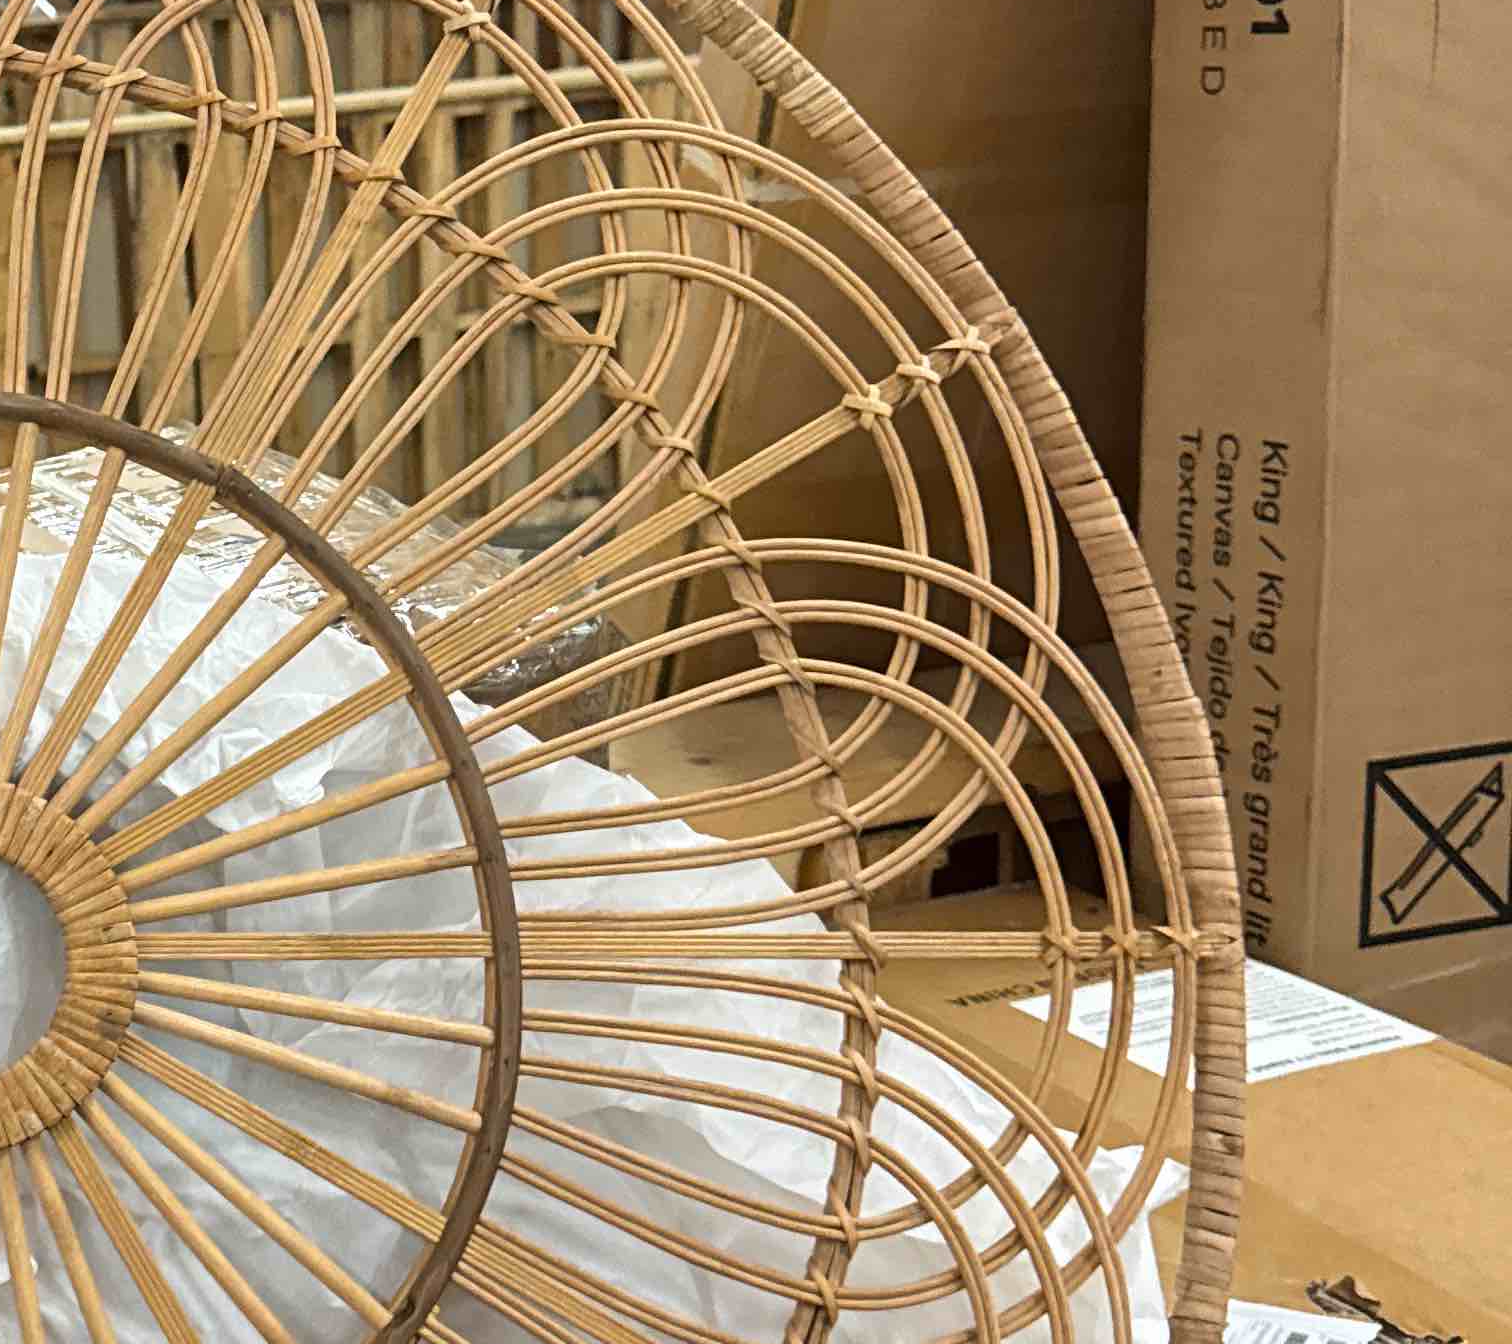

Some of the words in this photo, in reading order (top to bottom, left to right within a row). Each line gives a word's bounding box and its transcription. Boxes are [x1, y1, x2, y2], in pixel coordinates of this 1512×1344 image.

[1175, 427, 1203, 593] Textured
[1212, 433, 1240, 568] Canvas
[1253, 439, 1289, 526] King
[1248, 572, 1285, 656] King
[1206, 613, 1236, 720] Tejido
[1251, 704, 1281, 783] Très
[1243, 792, 1273, 903] grand
[1243, 911, 1273, 947] lit
